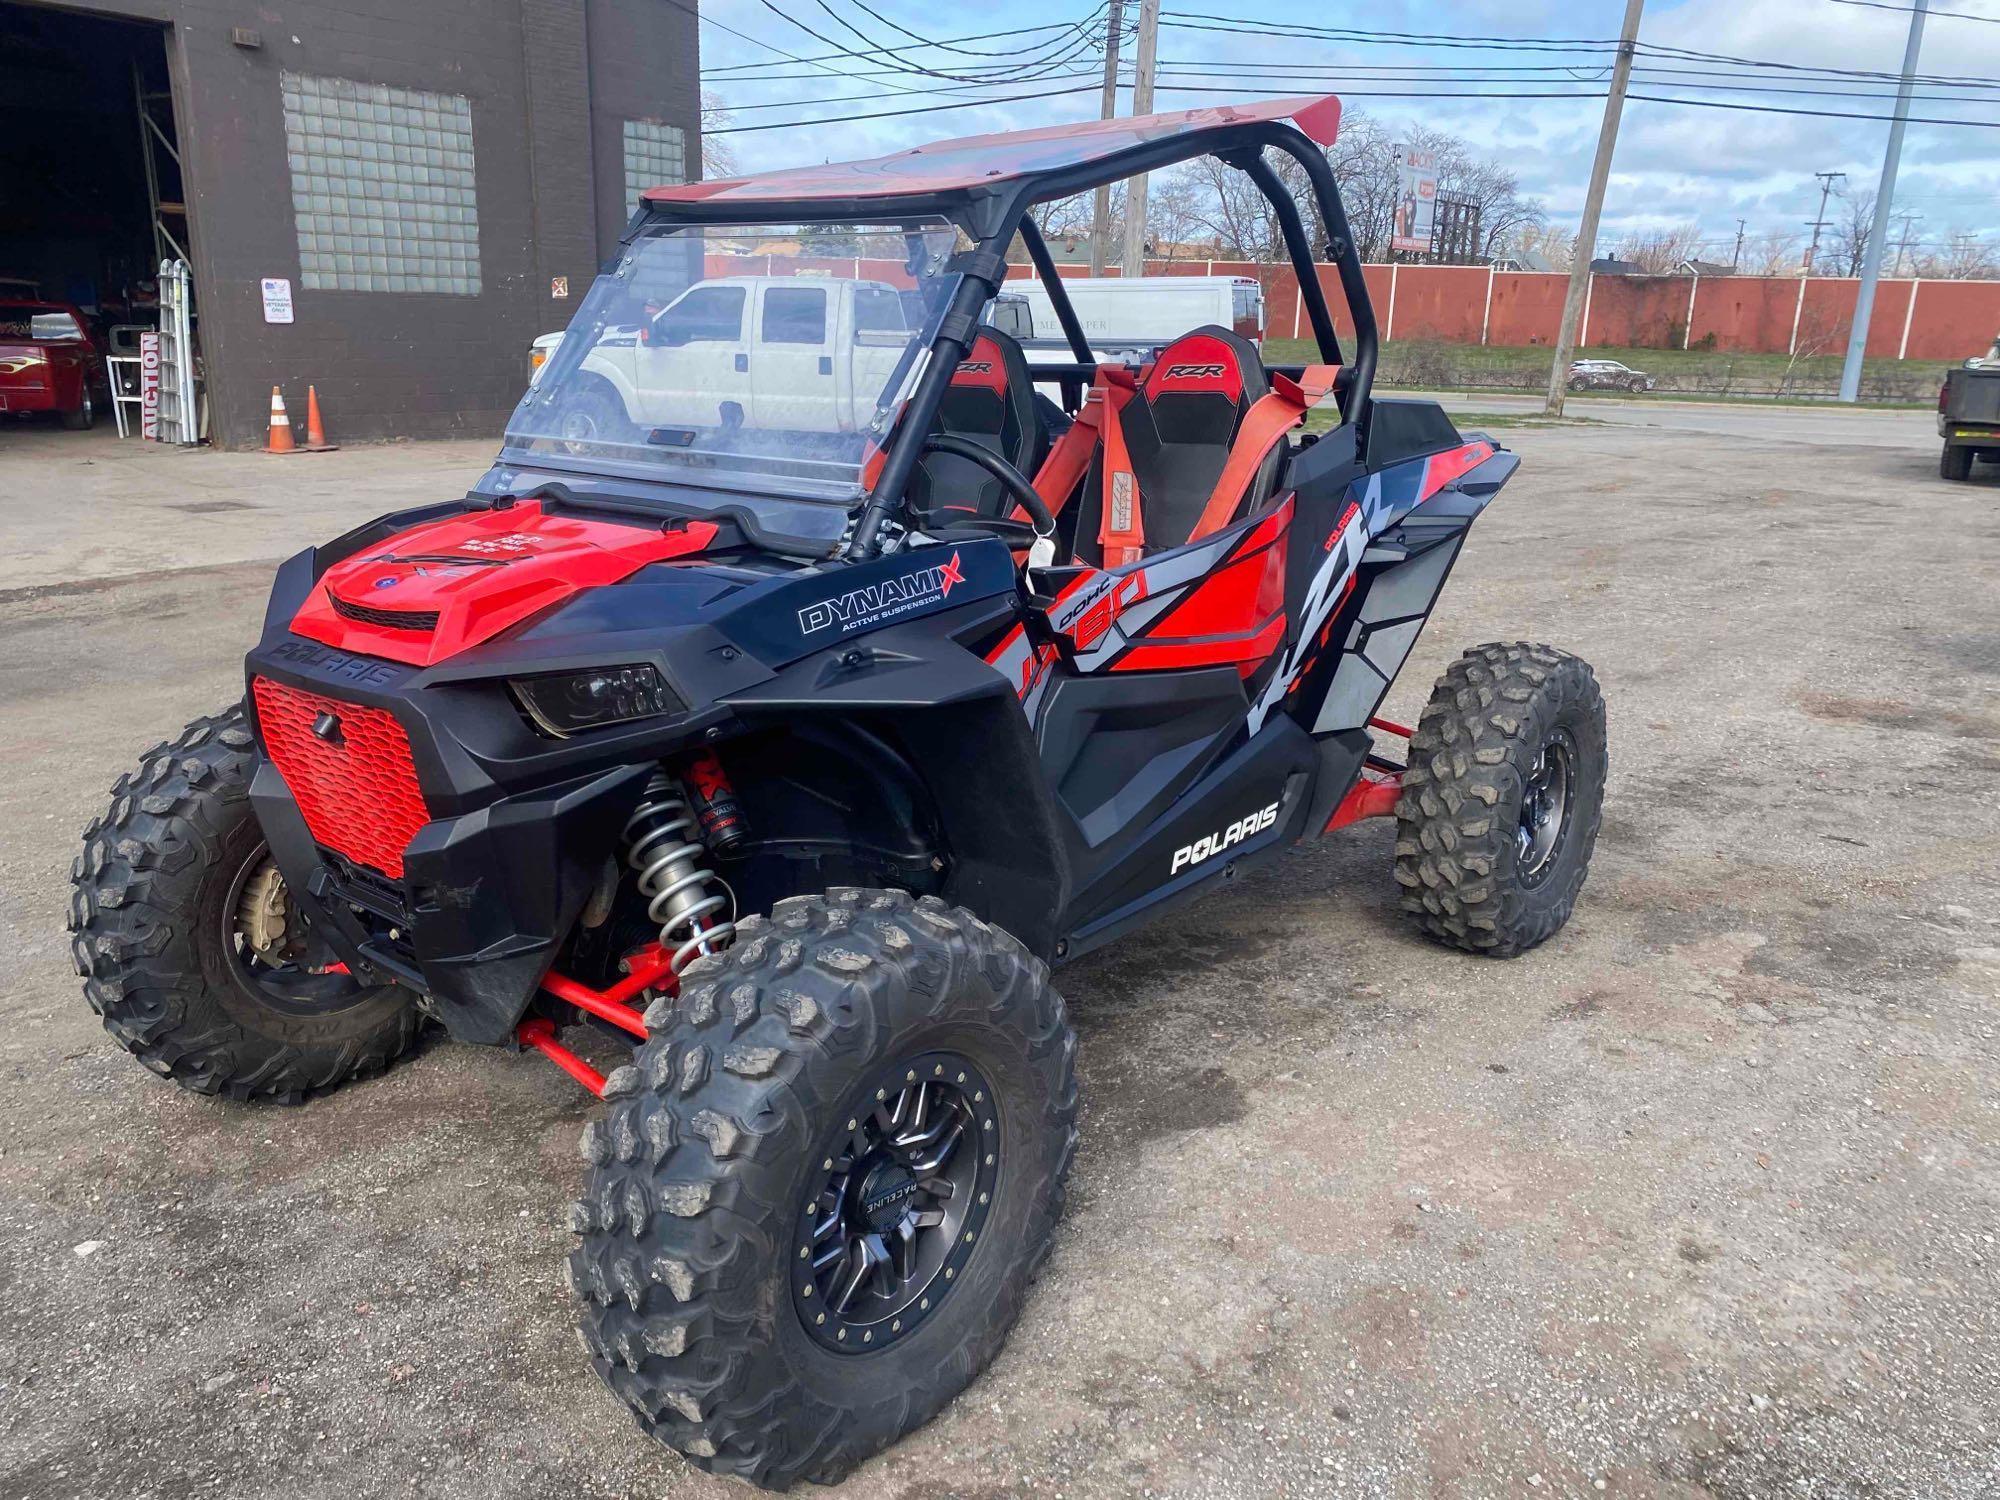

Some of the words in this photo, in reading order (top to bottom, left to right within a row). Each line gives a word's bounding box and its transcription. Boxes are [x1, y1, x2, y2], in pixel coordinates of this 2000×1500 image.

[143, 334, 158, 440] AUCTION
[955, 361, 992, 375] ZR
[1162, 364, 1227, 380] RZR
[1324, 501, 1360, 552] POLARIS
[798, 549, 966, 635] DYNAMIX
[842, 613, 880, 632] ACTIVE
[881, 594, 941, 619] SUSPENSION
[1059, 577, 1111, 630] DOHC
[267, 642, 401, 684] POLARIS
[1170, 801, 1279, 875] POLARIS
[866, 1182, 918, 1214] RACELINE
